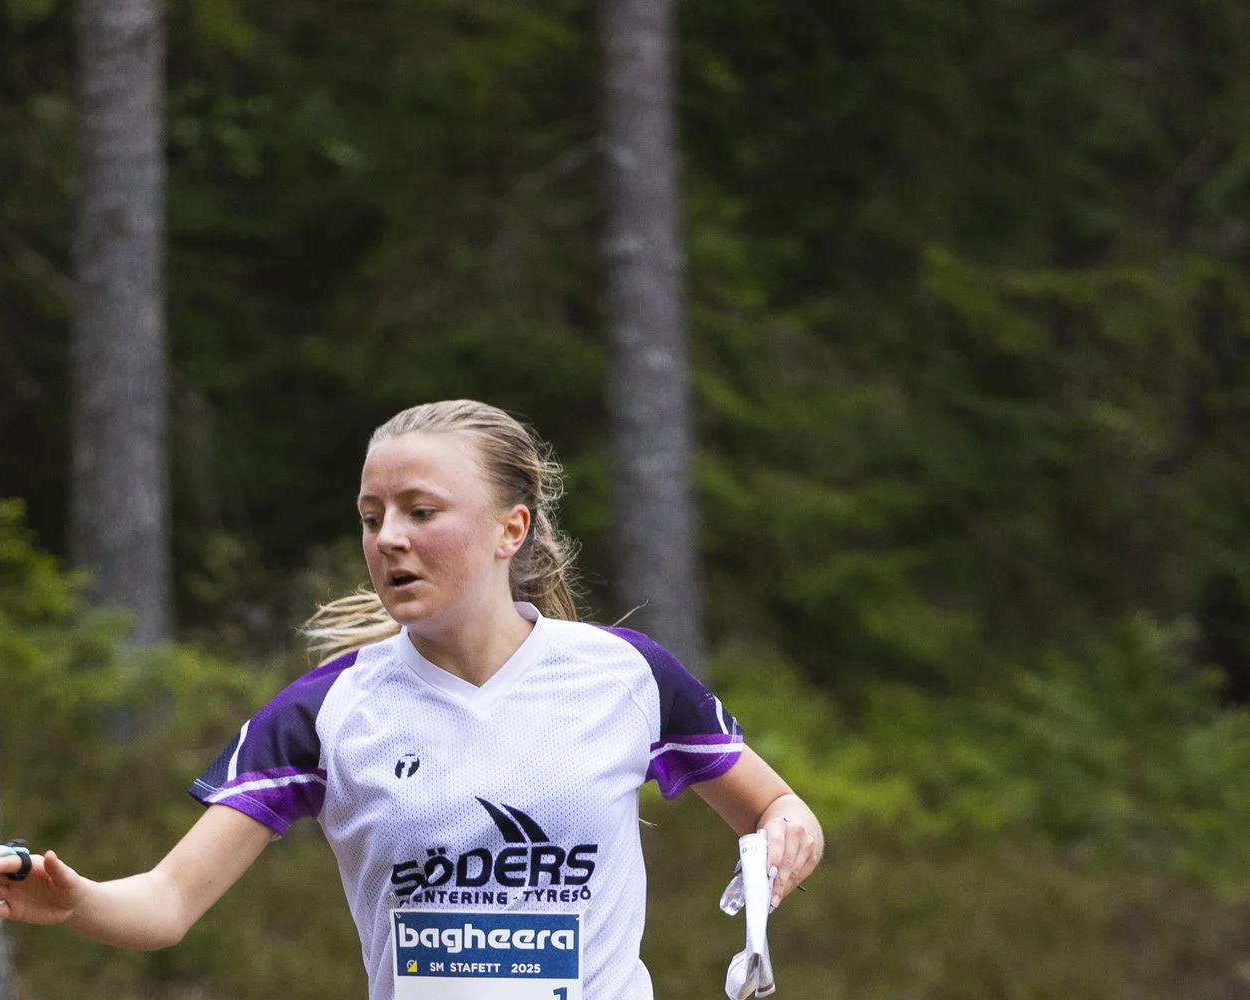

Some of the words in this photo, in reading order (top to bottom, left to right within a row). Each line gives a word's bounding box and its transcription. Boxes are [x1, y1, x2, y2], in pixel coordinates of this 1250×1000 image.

[391, 844, 598, 896] SÖDERS
[523, 885, 592, 903] TYRESÖ
[398, 923, 575, 953] bagheera
[430, 962, 444, 972] SM
[450, 962, 501, 973] STAFETT
[511, 963, 541, 973] 2025
